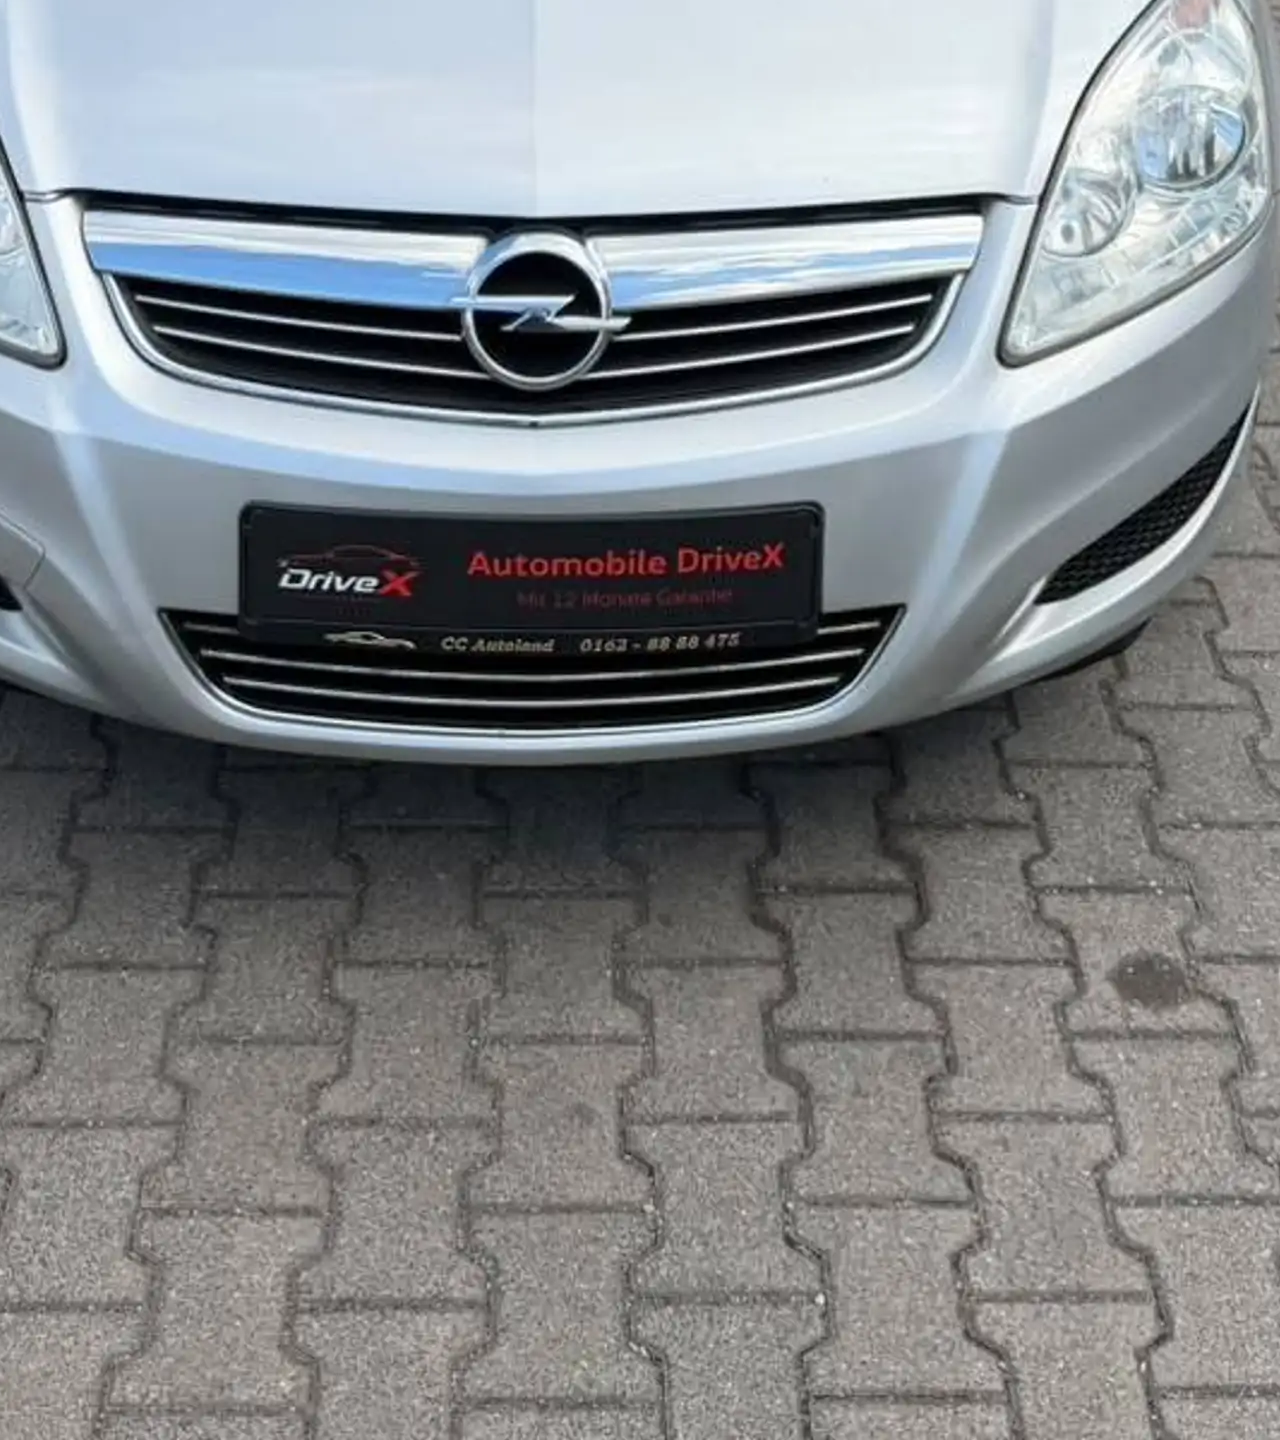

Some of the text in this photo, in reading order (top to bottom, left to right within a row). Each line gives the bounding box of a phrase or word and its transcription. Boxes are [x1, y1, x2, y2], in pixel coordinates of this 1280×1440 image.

[467, 541, 785, 580] Automobile DriveX
[277, 567, 421, 597] DriveX
[441, 636, 468, 651] CC
[471, 638, 555, 653] Autoland
